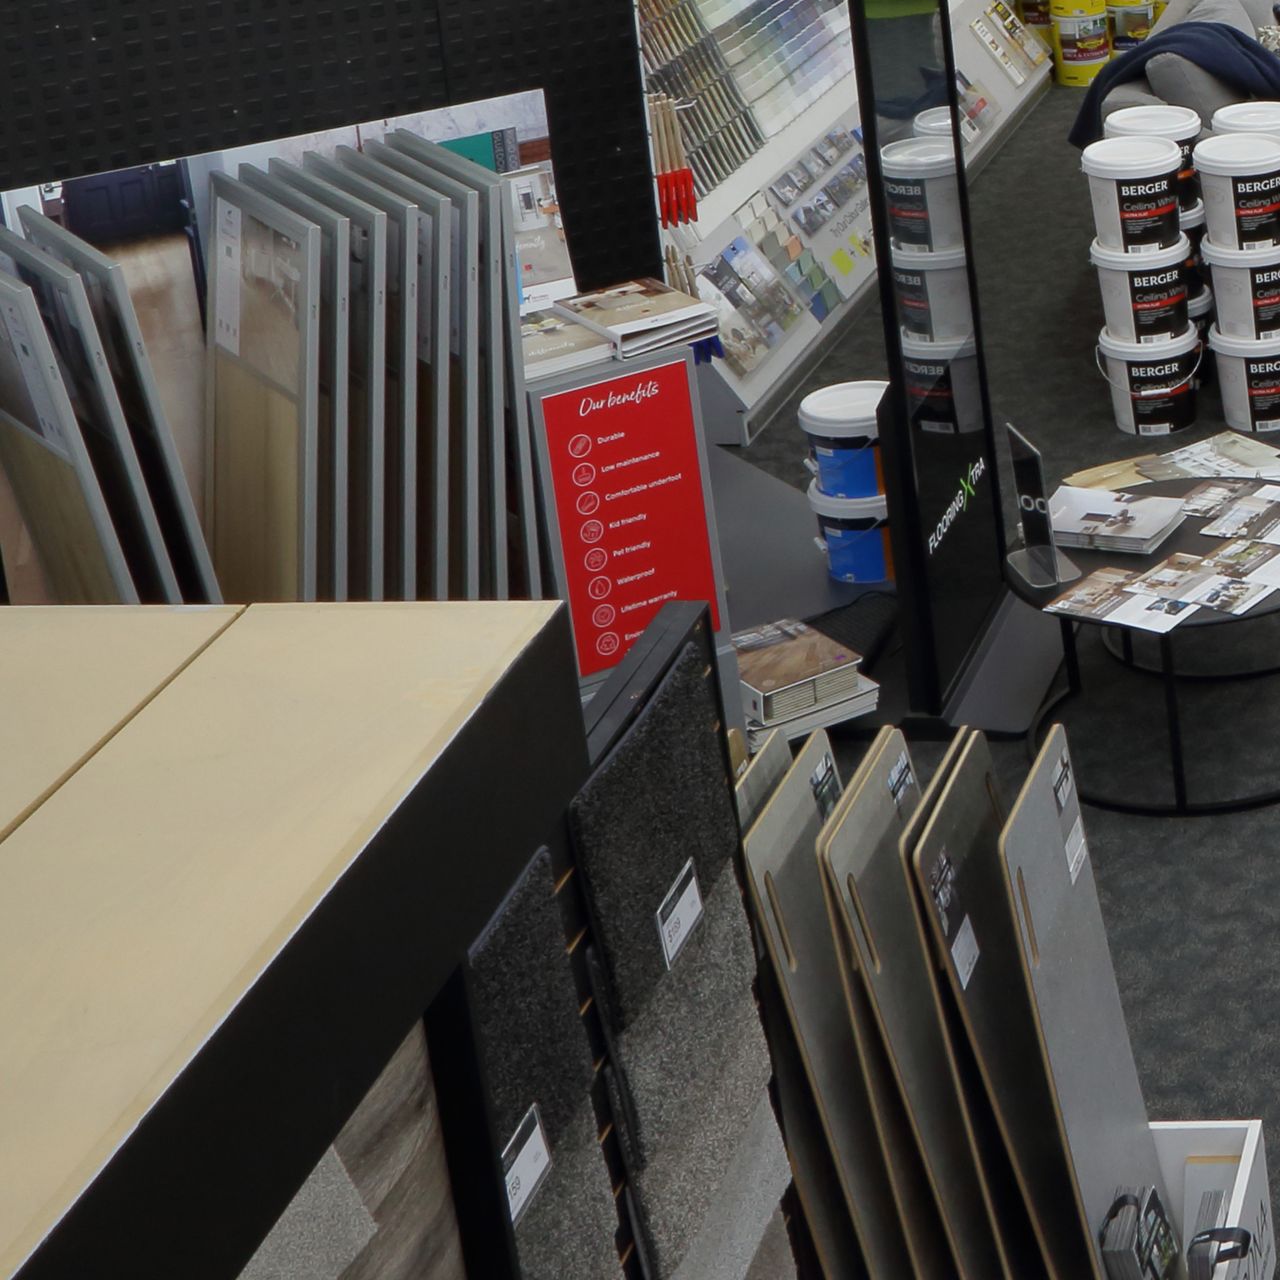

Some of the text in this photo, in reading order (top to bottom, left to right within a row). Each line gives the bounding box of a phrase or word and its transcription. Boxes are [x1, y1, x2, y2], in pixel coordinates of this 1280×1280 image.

[1121, 180, 1169, 197] BERGER
[1123, 202, 1156, 211] Ceiling
[1238, 198, 1271, 210] Ceiling
[1133, 270, 1179, 287] BERGER
[1135, 291, 1168, 303] Ceiling
[1131, 363, 1179, 377] BERGER
[579, 381, 660, 417] Our benefits
[597, 431, 625, 445] Durable
[601, 451, 660, 473] Low maintenance
[605, 473, 682, 501] Comfortable underfoot
[609, 513, 647, 529] Kid friendly
[613, 540, 651, 557] Pet friendly
[617, 567, 655, 585] Waterproof
[621, 590, 677, 613] Lifetime warranty
